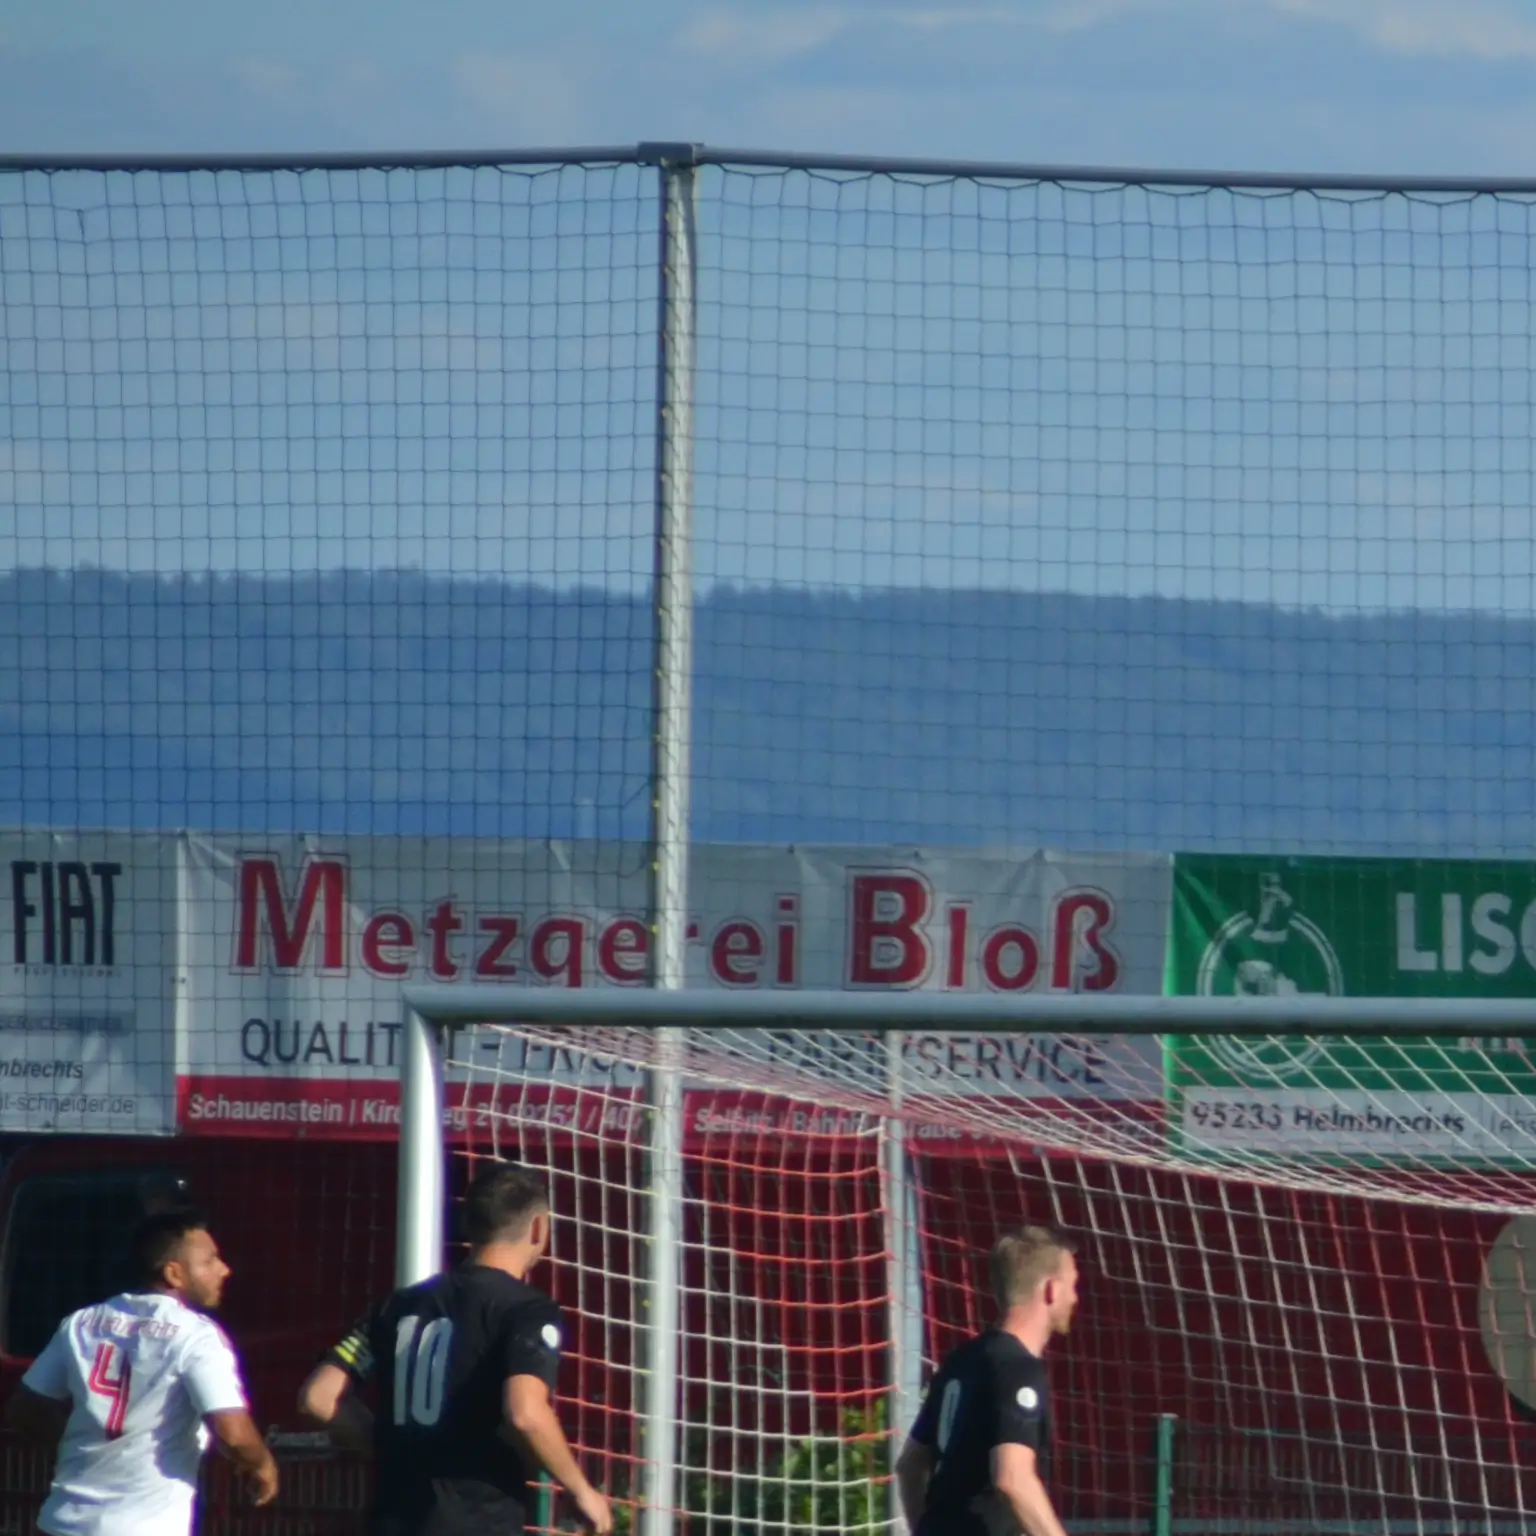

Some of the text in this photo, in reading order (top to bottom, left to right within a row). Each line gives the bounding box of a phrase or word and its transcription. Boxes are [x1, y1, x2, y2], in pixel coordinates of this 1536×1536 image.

[11, 859, 122, 966] FIAT
[846, 866, 1121, 992] Bloß
[188, 1092, 342, 1126] Schauenstein
[1293, 1102, 1465, 1134] Helmbrechts
[89, 1342, 131, 1438] 4
[394, 1315, 454, 1426] 10
